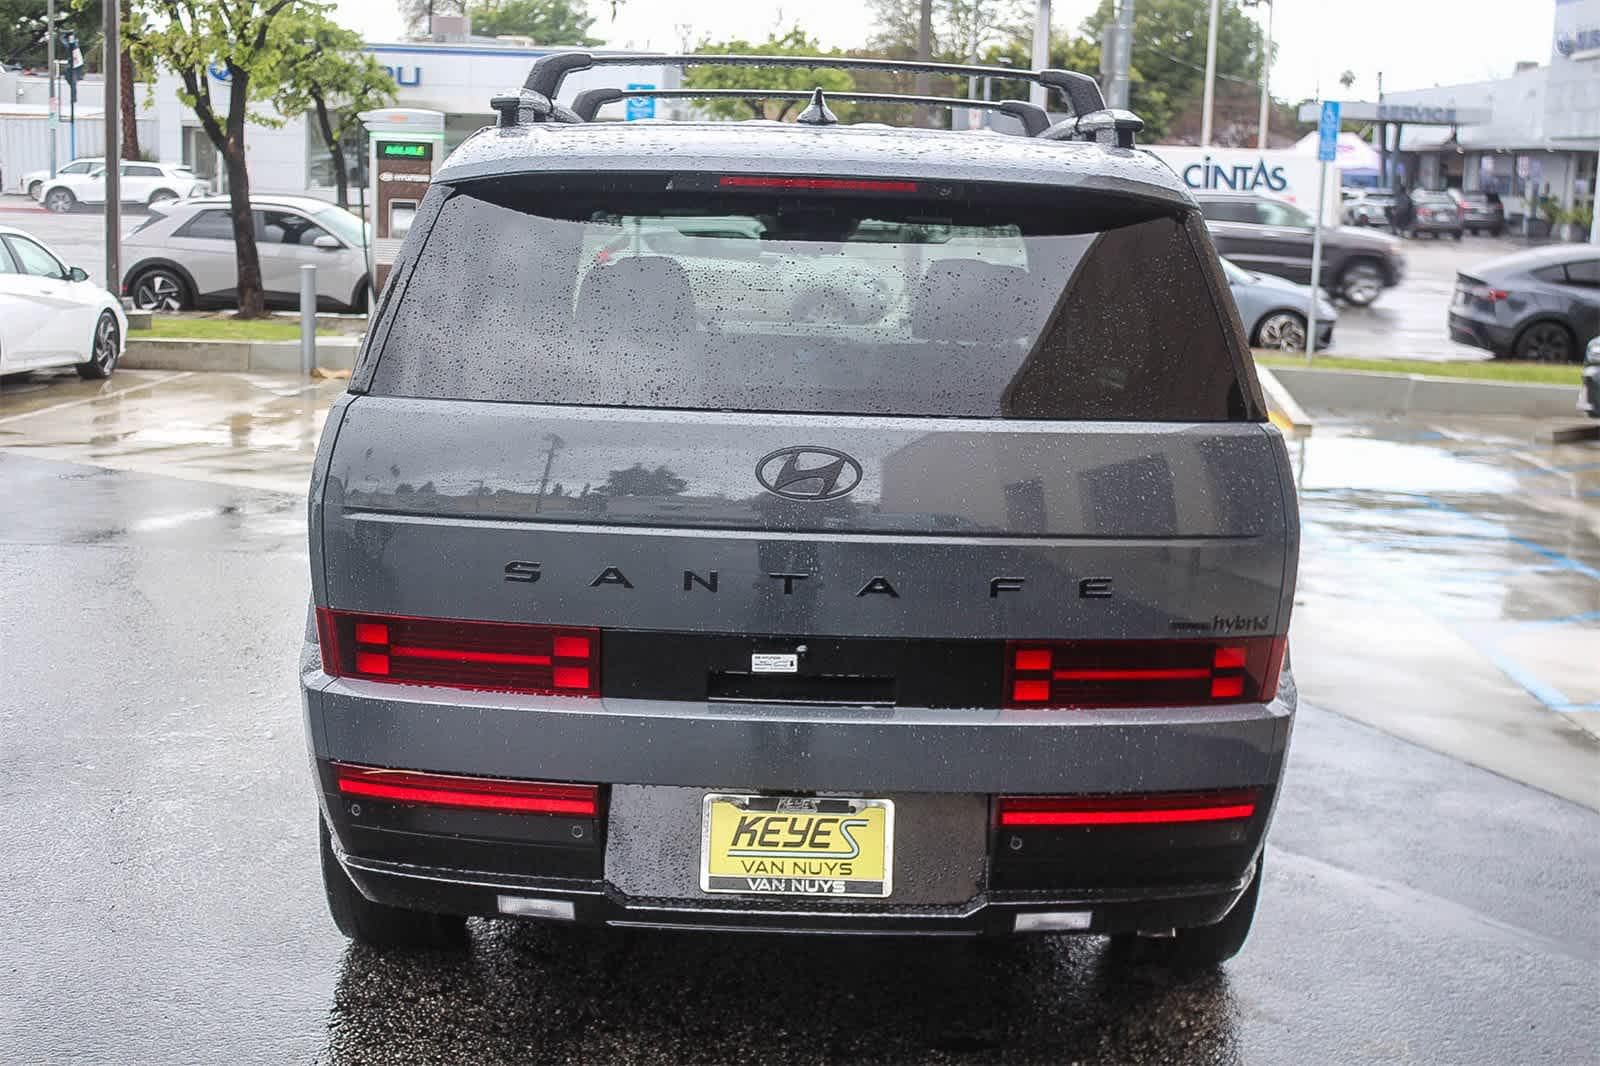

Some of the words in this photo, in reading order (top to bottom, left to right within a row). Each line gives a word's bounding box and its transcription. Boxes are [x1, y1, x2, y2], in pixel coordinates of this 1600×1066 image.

[1183, 156, 1287, 191] CINTAS
[503, 560, 899, 597] SANTA
[990, 576, 1113, 598] FE
[1213, 615, 1269, 633] hybrid
[727, 815, 869, 859] KEYES
[741, 860, 784, 874] VAN
[793, 861, 853, 876] NUYS
[747, 877, 785, 891] VAN
[792, 879, 846, 894] NUYS
